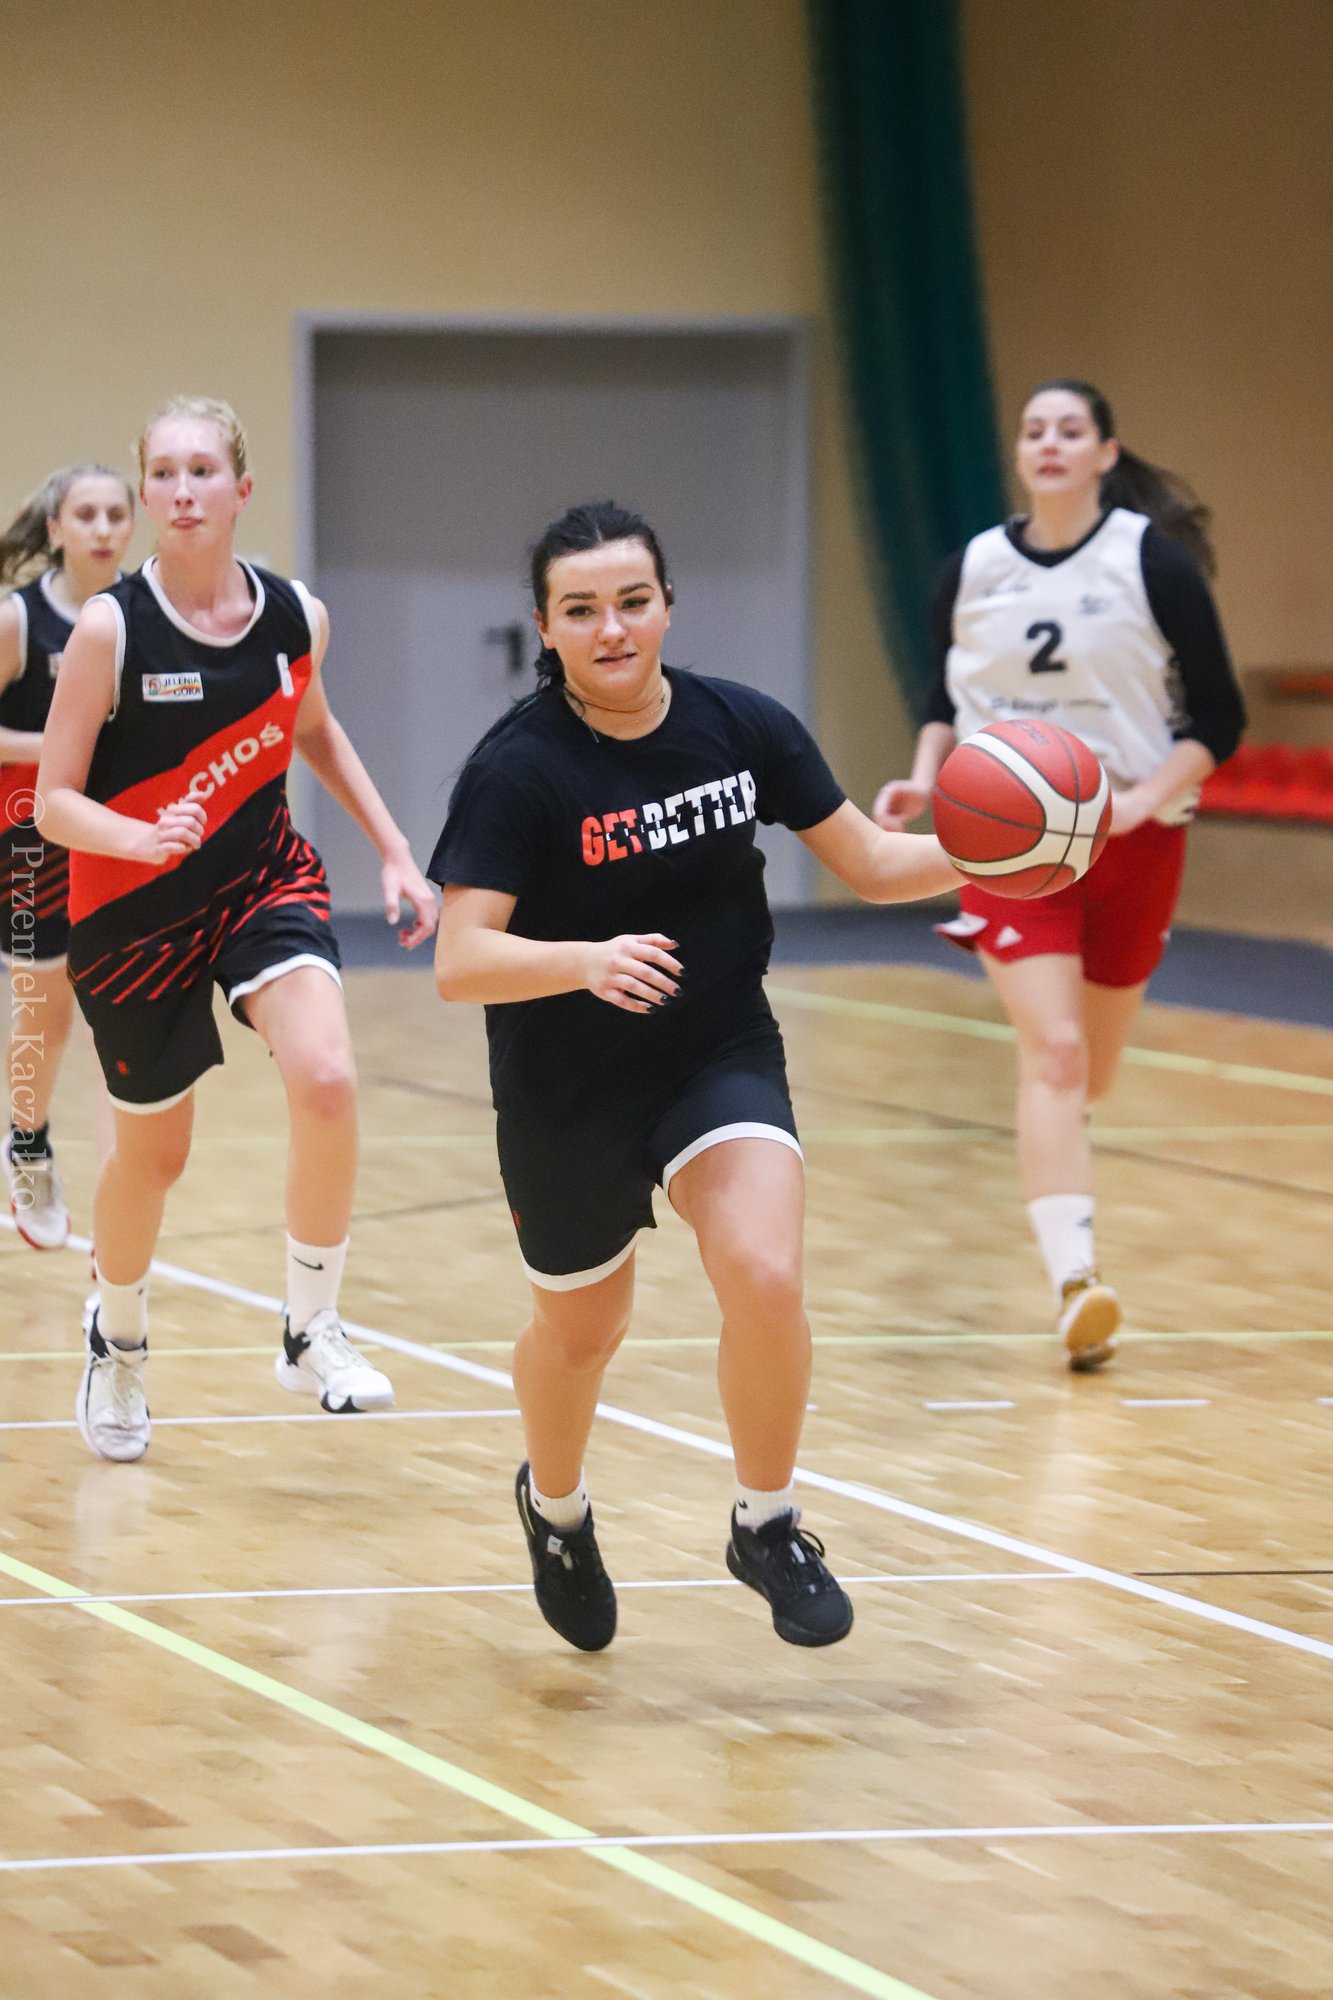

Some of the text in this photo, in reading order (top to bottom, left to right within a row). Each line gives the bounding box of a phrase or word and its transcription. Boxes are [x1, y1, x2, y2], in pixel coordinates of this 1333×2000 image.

[1026, 621, 1067, 674] 2
[156, 721, 285, 816] CHOŚ
[581, 769, 756, 866] GET BETTER
